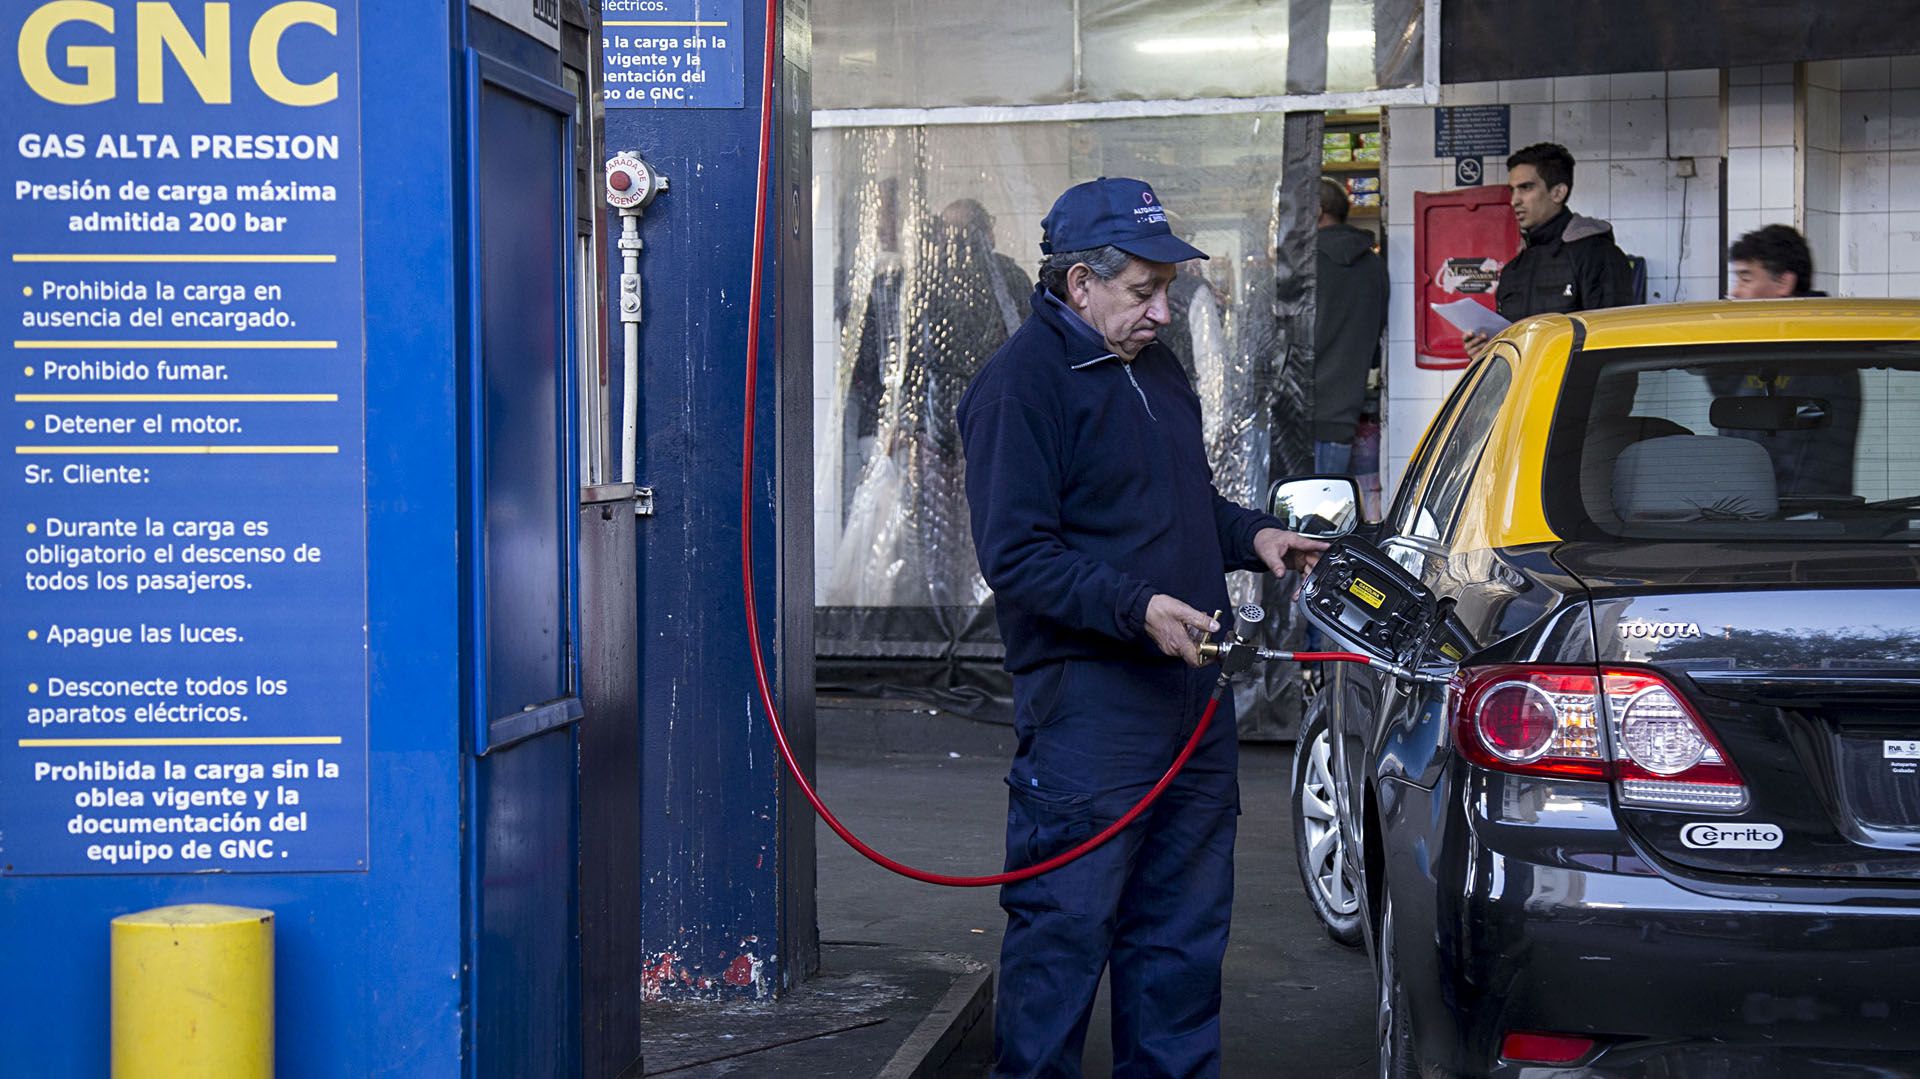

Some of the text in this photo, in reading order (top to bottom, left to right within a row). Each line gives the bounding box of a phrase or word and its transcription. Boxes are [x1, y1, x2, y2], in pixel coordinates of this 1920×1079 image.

[18, 0, 338, 106] GNC
[615, 36, 628, 47] la
[634, 39, 678, 50] carga
[683, 35, 707, 48] sin
[712, 35, 726, 48] la
[608, 52, 701, 67] vigente y la
[681, 70, 706, 82] del
[626, 87, 645, 99] de
[650, 87, 684, 100] GNC
[19, 134, 338, 159] GAS ALTA PRESION
[636, 170, 647, 183] DE
[16, 179, 336, 205] Presión de carga máxima
[69, 212, 287, 232] admitida 200 bar
[43, 281, 281, 304] Prohibida la carga en
[23, 308, 295, 331] ausencia del encargado.
[45, 361, 228, 380] Prohibido fumar.
[45, 414, 242, 433] Detener el motor.
[25, 464, 149, 483] Sr. Cliente:
[47, 517, 268, 540] Durante la carga es
[26, 543, 320, 568] obligatorio el descenso de
[26, 571, 252, 593] todos los pasajeros.
[47, 624, 243, 647] Apague las luces.
[1618, 622, 1701, 639] TOYOTA
[49, 676, 287, 696] Desconecte todos los
[28, 702, 247, 726] aparatos eléctricos.
[35, 759, 339, 783] Prohibida la carga sin la
[76, 786, 299, 813] oblea vigente y la
[68, 812, 306, 833] documentación del
[1686, 825, 1778, 846] Cerrito
[87, 840, 173, 864] equipo
[181, 840, 211, 859] de
[220, 839, 273, 858] GNC
